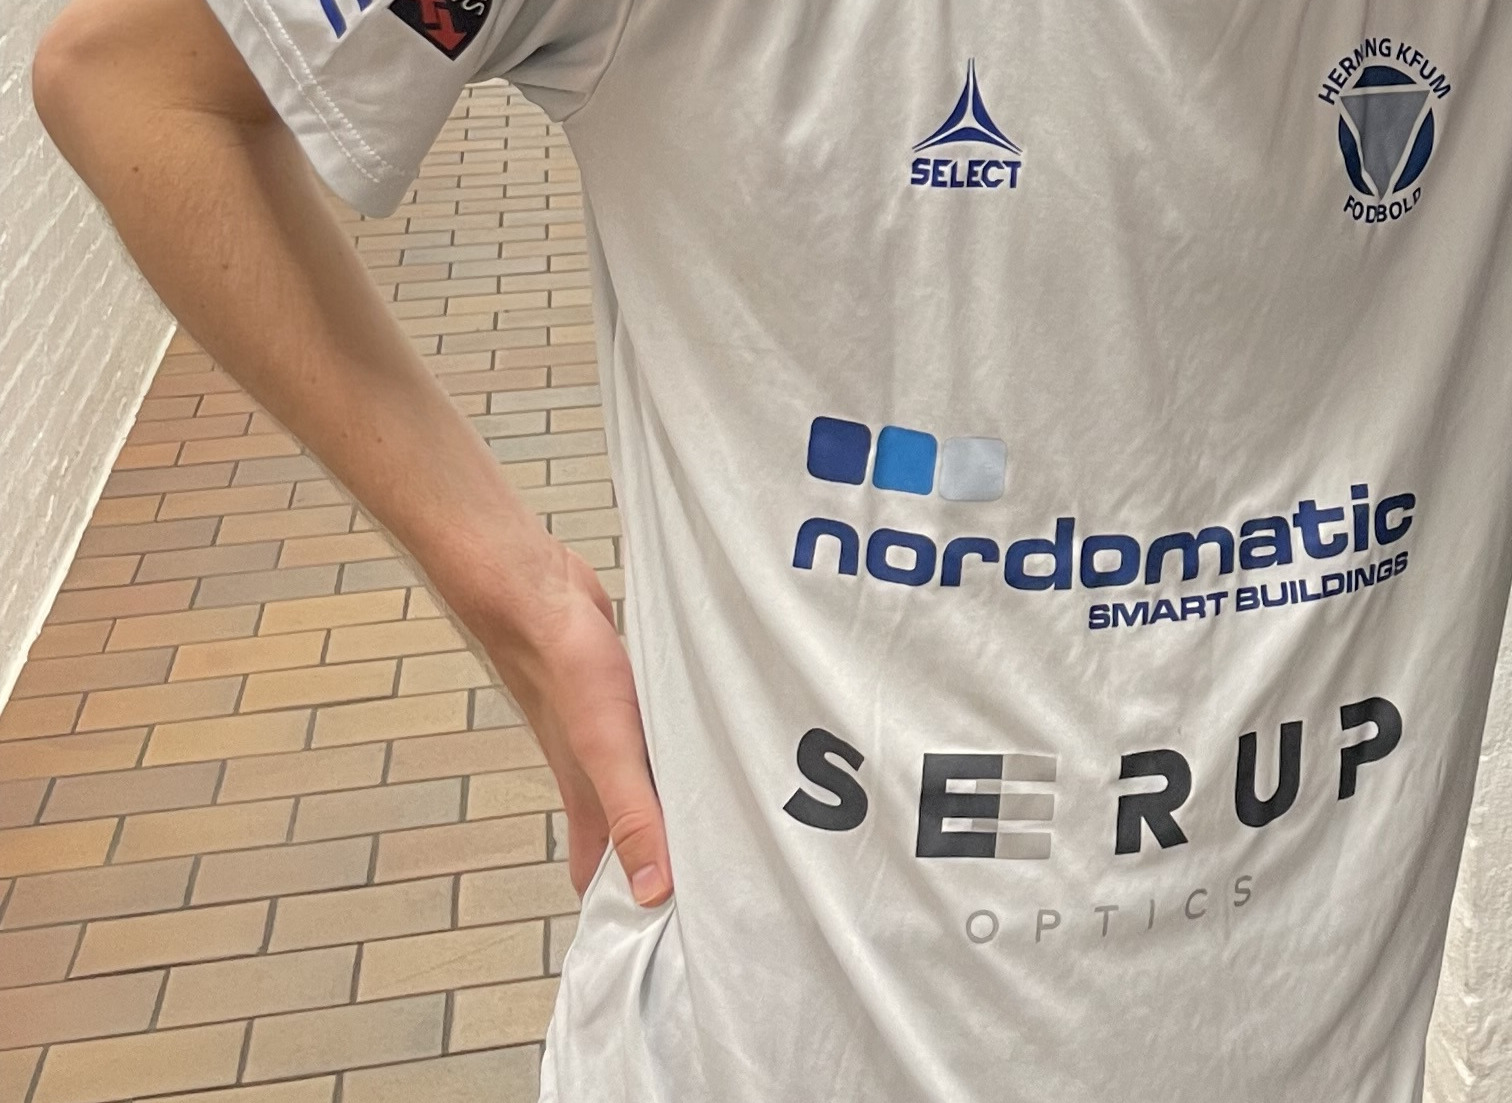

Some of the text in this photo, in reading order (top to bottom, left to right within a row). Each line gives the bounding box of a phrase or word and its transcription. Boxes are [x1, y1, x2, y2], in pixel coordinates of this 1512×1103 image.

[1317, 37, 1452, 106] HERNNG KFUM
[910, 157, 1022, 189] SELECT
[1343, 186, 1422, 224] FODBOLD
[792, 484, 1417, 591] nordomatic
[1088, 550, 1410, 630] SMART BUILDINGS
[783, 696, 1404, 859] SERUP
[965, 875, 1254, 944] OPTICS
